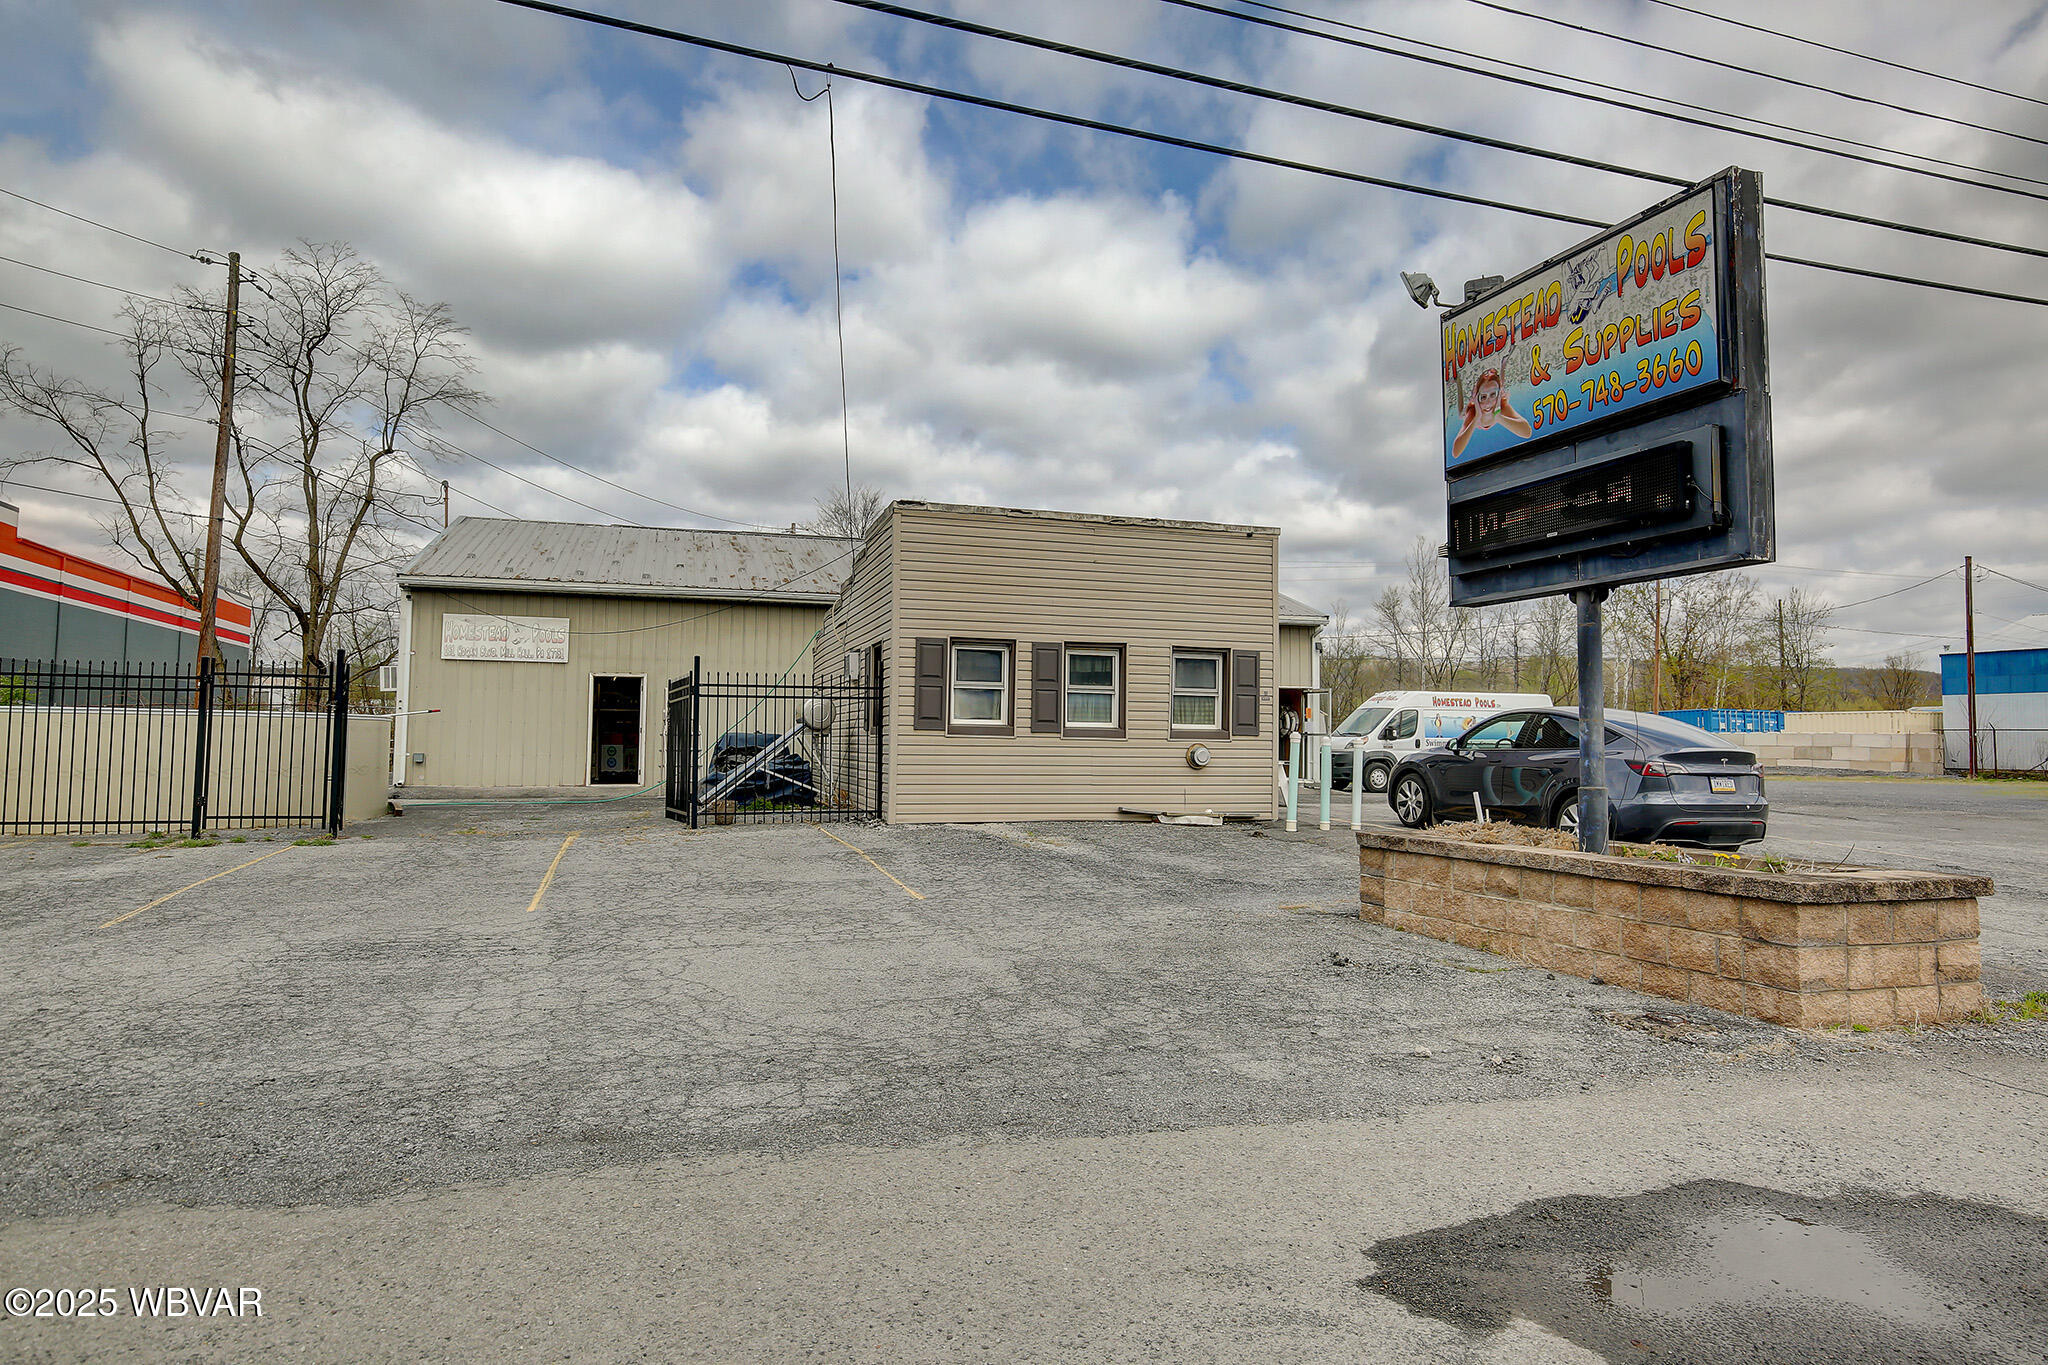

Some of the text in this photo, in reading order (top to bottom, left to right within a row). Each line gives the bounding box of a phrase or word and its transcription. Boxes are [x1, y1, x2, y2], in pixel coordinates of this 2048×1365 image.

[1444, 209, 1707, 381] HOMESTEAD POOLS
[1529, 288, 1702, 386] & SUPPLIES
[1531, 339, 1703, 430] 570-748-3660
[444, 620, 566, 644] HOMESTEAD POOLS
[1432, 696, 1472, 707] HOMESTEAD
[1474, 697, 1496, 708] POOLS
